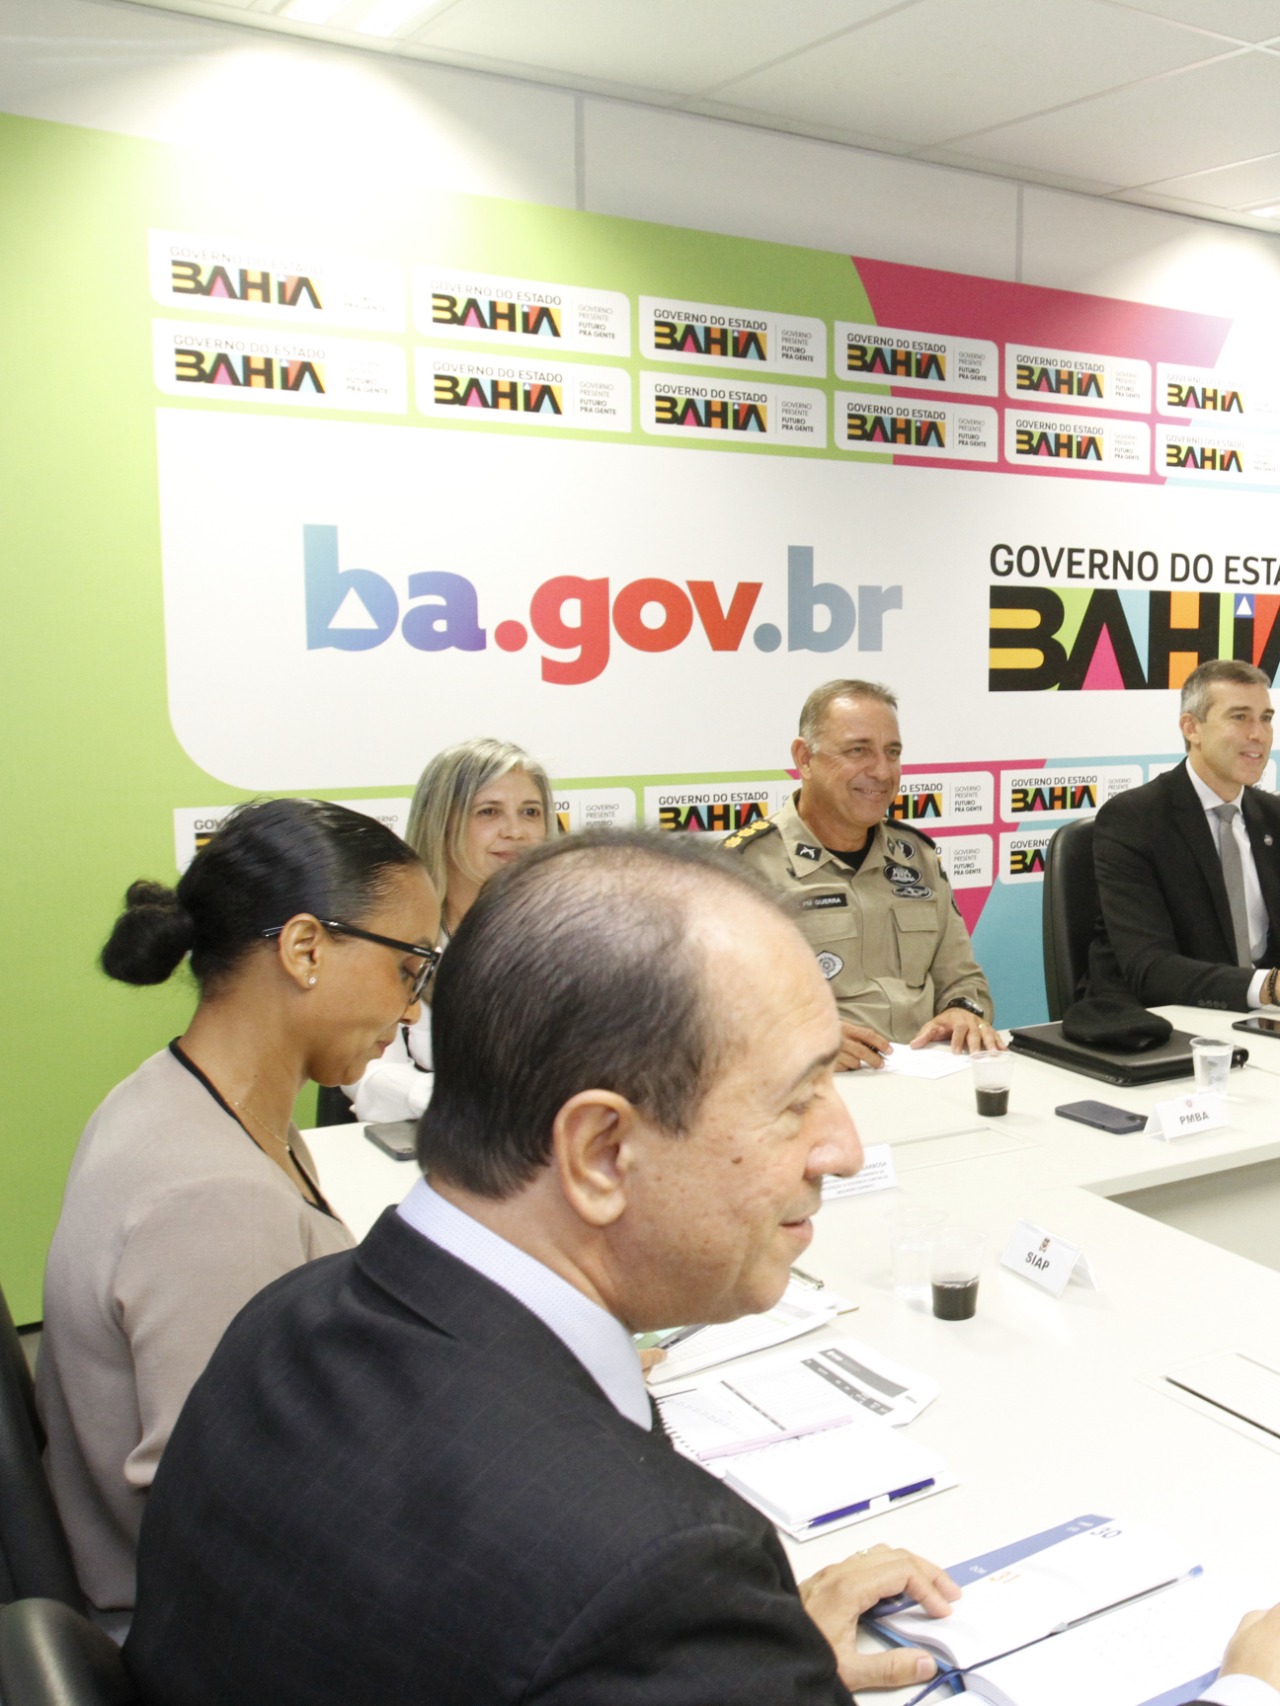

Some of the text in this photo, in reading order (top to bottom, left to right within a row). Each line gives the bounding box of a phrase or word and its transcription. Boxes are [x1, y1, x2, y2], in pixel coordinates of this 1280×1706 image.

[171, 260, 323, 309] BAHIA
[432, 281, 562, 306] GOVERNO DO ESTADO
[432, 293, 562, 338] BAHIA
[579, 322, 606, 331] FUTURO
[654, 309, 767, 330] GOVERNO DO ESTADO
[593, 332, 615, 340] GENTE
[654, 320, 767, 361] BAHIA
[847, 332, 946, 354] GOVERNO DO ESTADO
[174, 335, 326, 360] GOVERNO DO ESTADO
[782, 345, 805, 353] FUTURO
[795, 354, 814, 362] GENTE
[174, 348, 326, 394] BAHIA
[847, 342, 946, 380] BAHIA
[1017, 355, 1104, 372] GOVERNO DO ESTADO
[434, 362, 563, 383] GOVERNO DO ESTADO
[1017, 364, 1104, 398] BAHIA
[434, 374, 563, 416] BAHIA
[580, 399, 606, 408] FUTURO
[656, 383, 767, 404] GOVERNO DO ESTADO
[1168, 383, 1244, 414] BAHIA
[594, 408, 616, 416] GENTE
[656, 394, 767, 432] BAHIA
[782, 417, 805, 425] FUTURO
[848, 402, 946, 421] GOVERNO DO ESTADO
[848, 413, 946, 448] BAHIA
[1016, 420, 1103, 435] GOVERNO DO ESTADO
[1016, 430, 1103, 460] BAHIA
[1166, 444, 1243, 472] BAHIA
[989, 543, 1159, 582] GOVERNO
[1169, 553, 1214, 584] DO
[303, 524, 902, 685] ba.gov.br
[910, 783, 943, 792] ESTADO
[1011, 775, 1097, 788] GOVERNO DO ESTADO
[585, 803, 619, 811] GOVERNO
[659, 791, 768, 805] GOVERNO DO ESTADO
[888, 793, 943, 819] HIA
[1011, 785, 1097, 813] BAHIA
[658, 802, 768, 833] BAHIA
[1179, 1111, 1210, 1125] PMBA
[1025, 1251, 1050, 1271] SIAP
